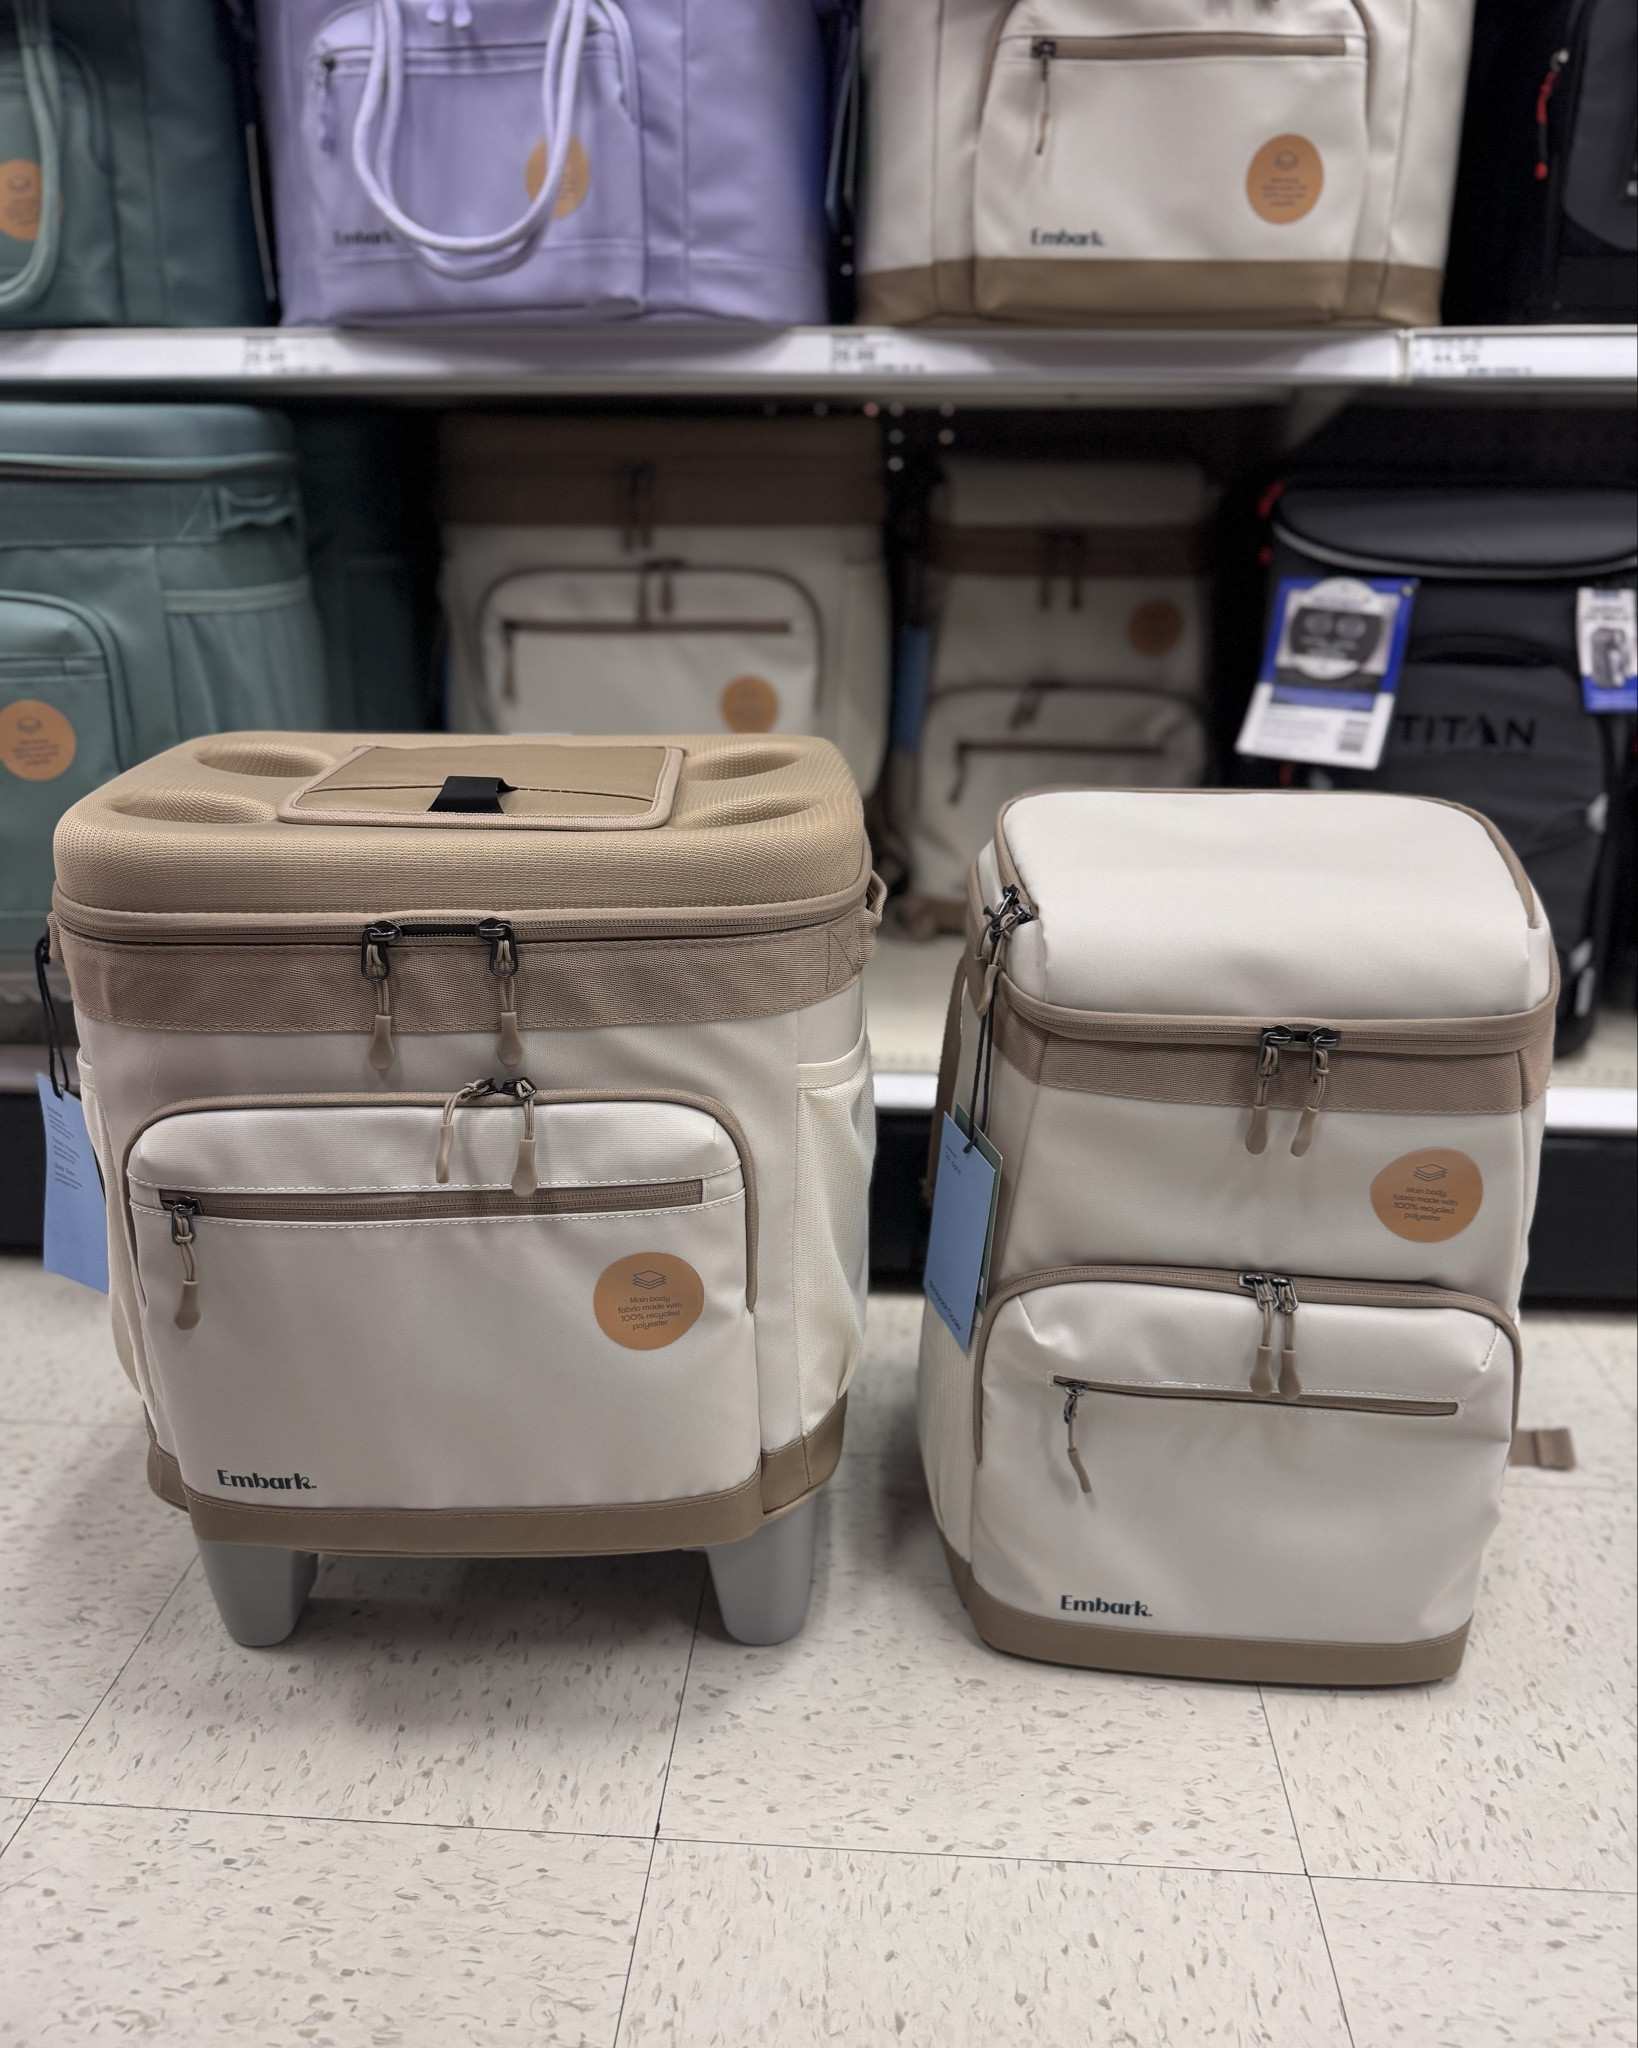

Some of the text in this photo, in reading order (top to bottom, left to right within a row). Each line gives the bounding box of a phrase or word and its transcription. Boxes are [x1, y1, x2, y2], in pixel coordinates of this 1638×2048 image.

[1394, 713, 1537, 747] TITAN
[1394, 1202, 1418, 1210] 100%
[650, 1295, 671, 1303] body
[618, 1305, 641, 1314] fabric
[642, 1303, 665, 1311] made
[620, 1310, 680, 1322] 100% recycled
[632, 1319, 669, 1331] polyester
